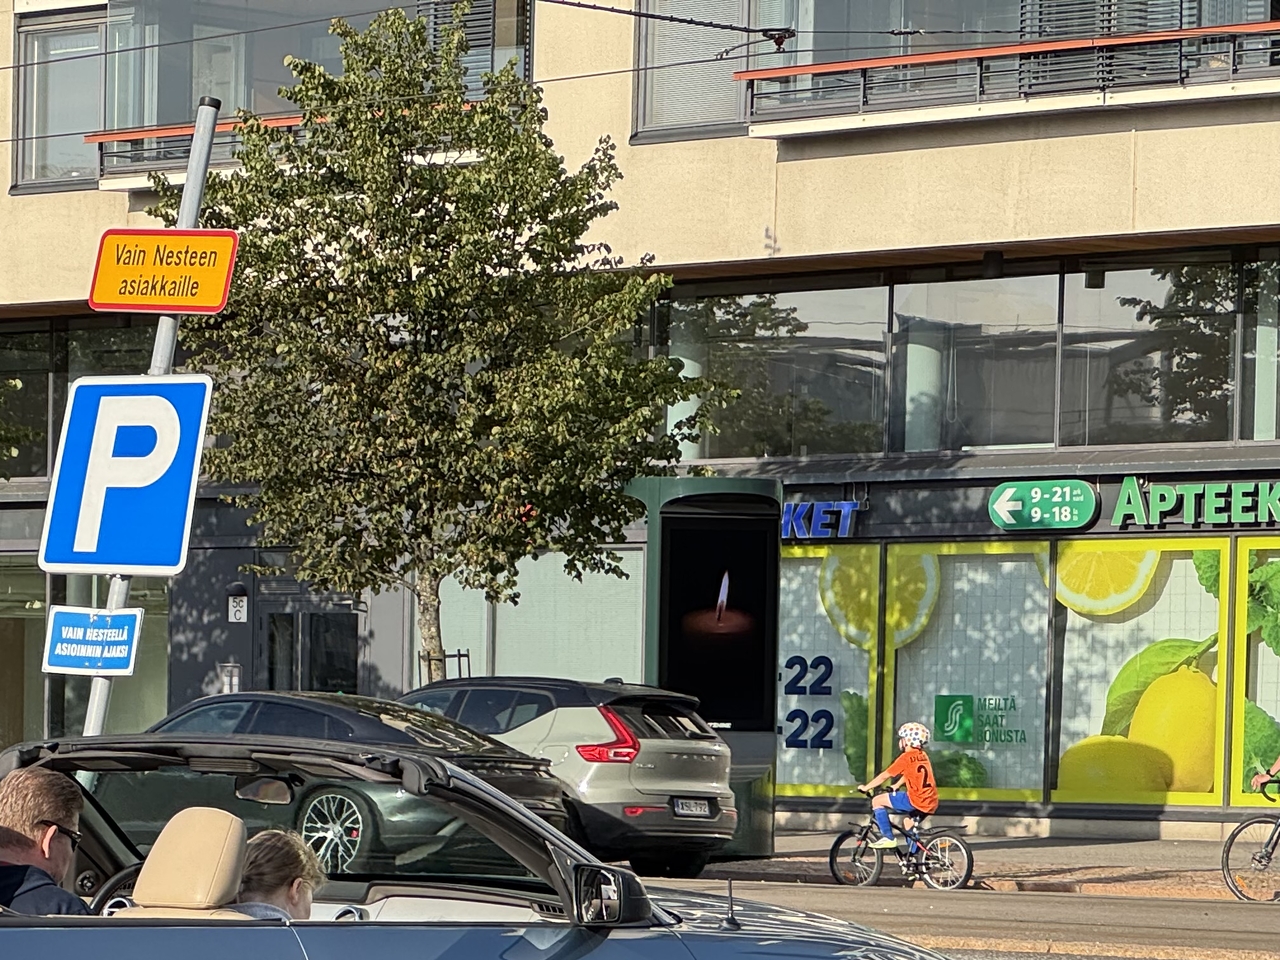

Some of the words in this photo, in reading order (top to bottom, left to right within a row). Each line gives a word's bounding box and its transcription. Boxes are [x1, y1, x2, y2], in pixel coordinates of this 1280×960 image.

[116, 244, 147, 266] Vain
[153, 244, 218, 268] Nesteen
[119, 274, 199, 297] asiakkaille
[73, 395, 181, 553] P
[234, 609, 242, 621] C
[61, 626, 84, 640] VAIN
[86, 626, 128, 641] NESTEELLÄ
[55, 643, 102, 657] ASIOINNIN
[103, 645, 128, 657] AJAKSI
[977, 695, 1016, 711] MEILTÄ
[977, 714, 1006, 727] SAAT
[977, 729, 1027, 743] BONUSTA
[917, 764, 932, 788] 2
